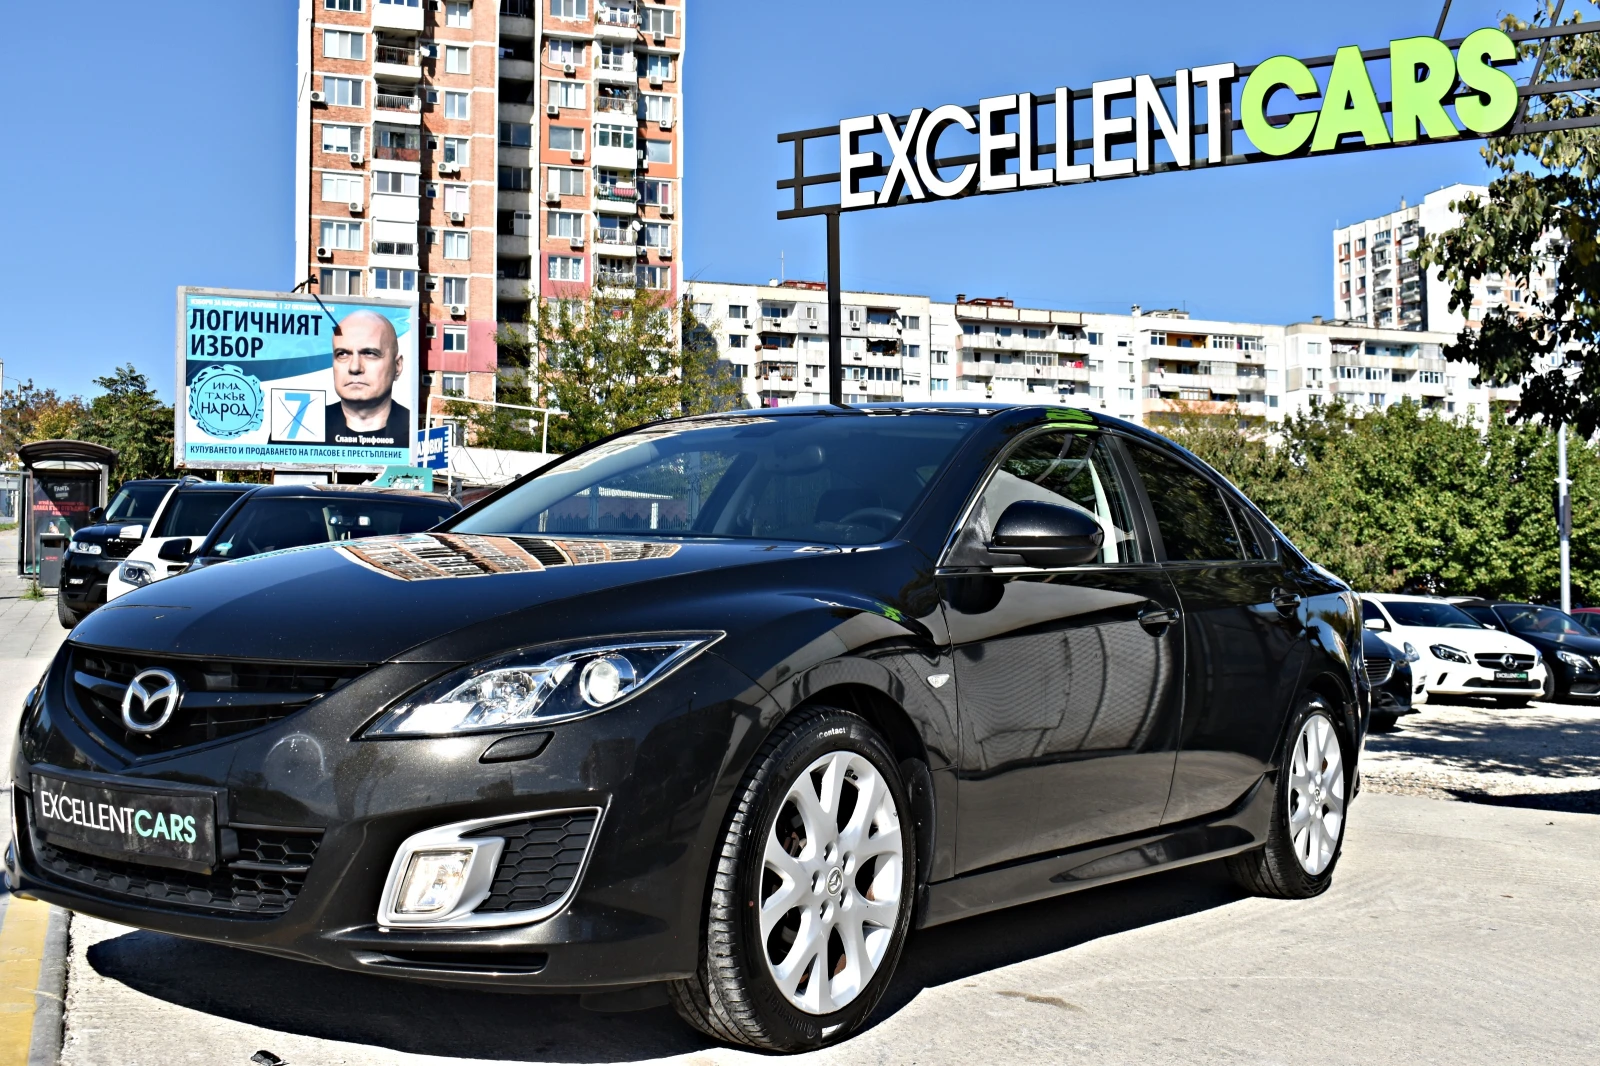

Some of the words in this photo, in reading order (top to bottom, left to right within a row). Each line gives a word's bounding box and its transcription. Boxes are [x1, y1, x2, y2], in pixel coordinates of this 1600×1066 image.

[190, 308, 322, 336] ЛОГИЧНИЯТ
[191, 334, 264, 358] ИЗБОР
[212, 382, 241, 390] ИМА
[205, 392, 246, 402] ТАКЪВ
[201, 402, 252, 422] НАРОД
[284, 392, 311, 440] 7
[335, 434, 358, 442] Слави
[358, 436, 394, 445] Трифонов
[190, 446, 236, 454] КУПУВАНЕТО
[246, 447, 298, 456] ПРОДАВАНЕТО
[310, 449, 340, 457] ГЛАСОВЕ
[347, 450, 402, 458] ПРЕСТЪПЛЕНИЕ
